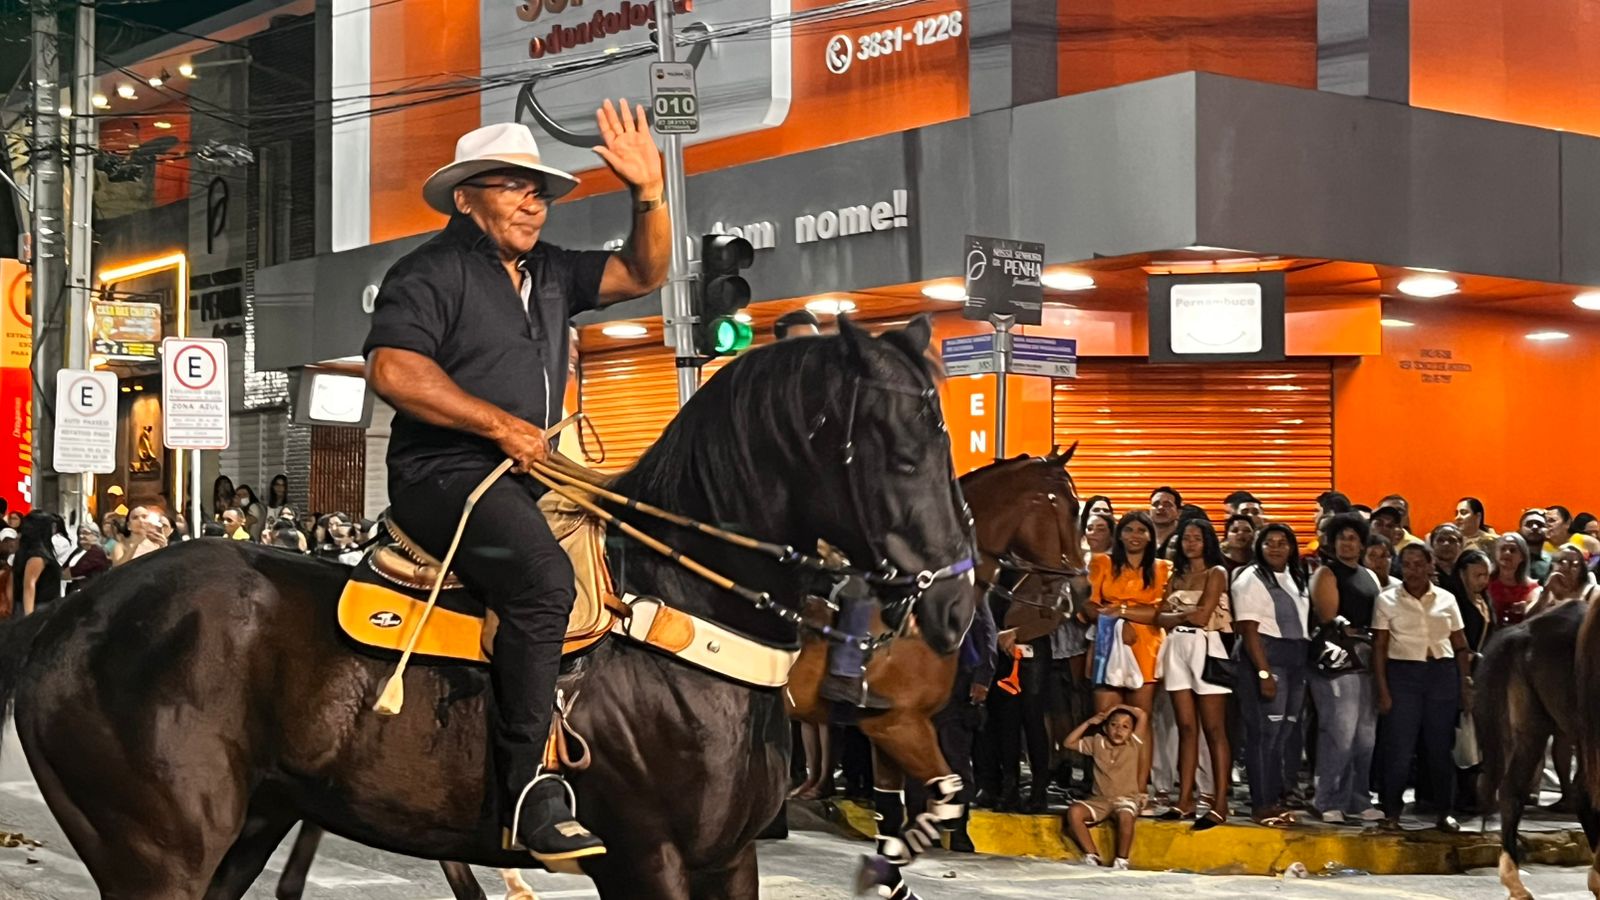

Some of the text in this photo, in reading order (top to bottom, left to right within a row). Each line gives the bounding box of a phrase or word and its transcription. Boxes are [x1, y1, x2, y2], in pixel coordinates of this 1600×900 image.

[857, 10, 963, 60] 3831-1228
[655, 97, 695, 115] 010
[1004, 259, 1042, 278] PENHA
[187, 356, 202, 379] E
[81, 386, 93, 407] E
[199, 403, 220, 411] AZUL
